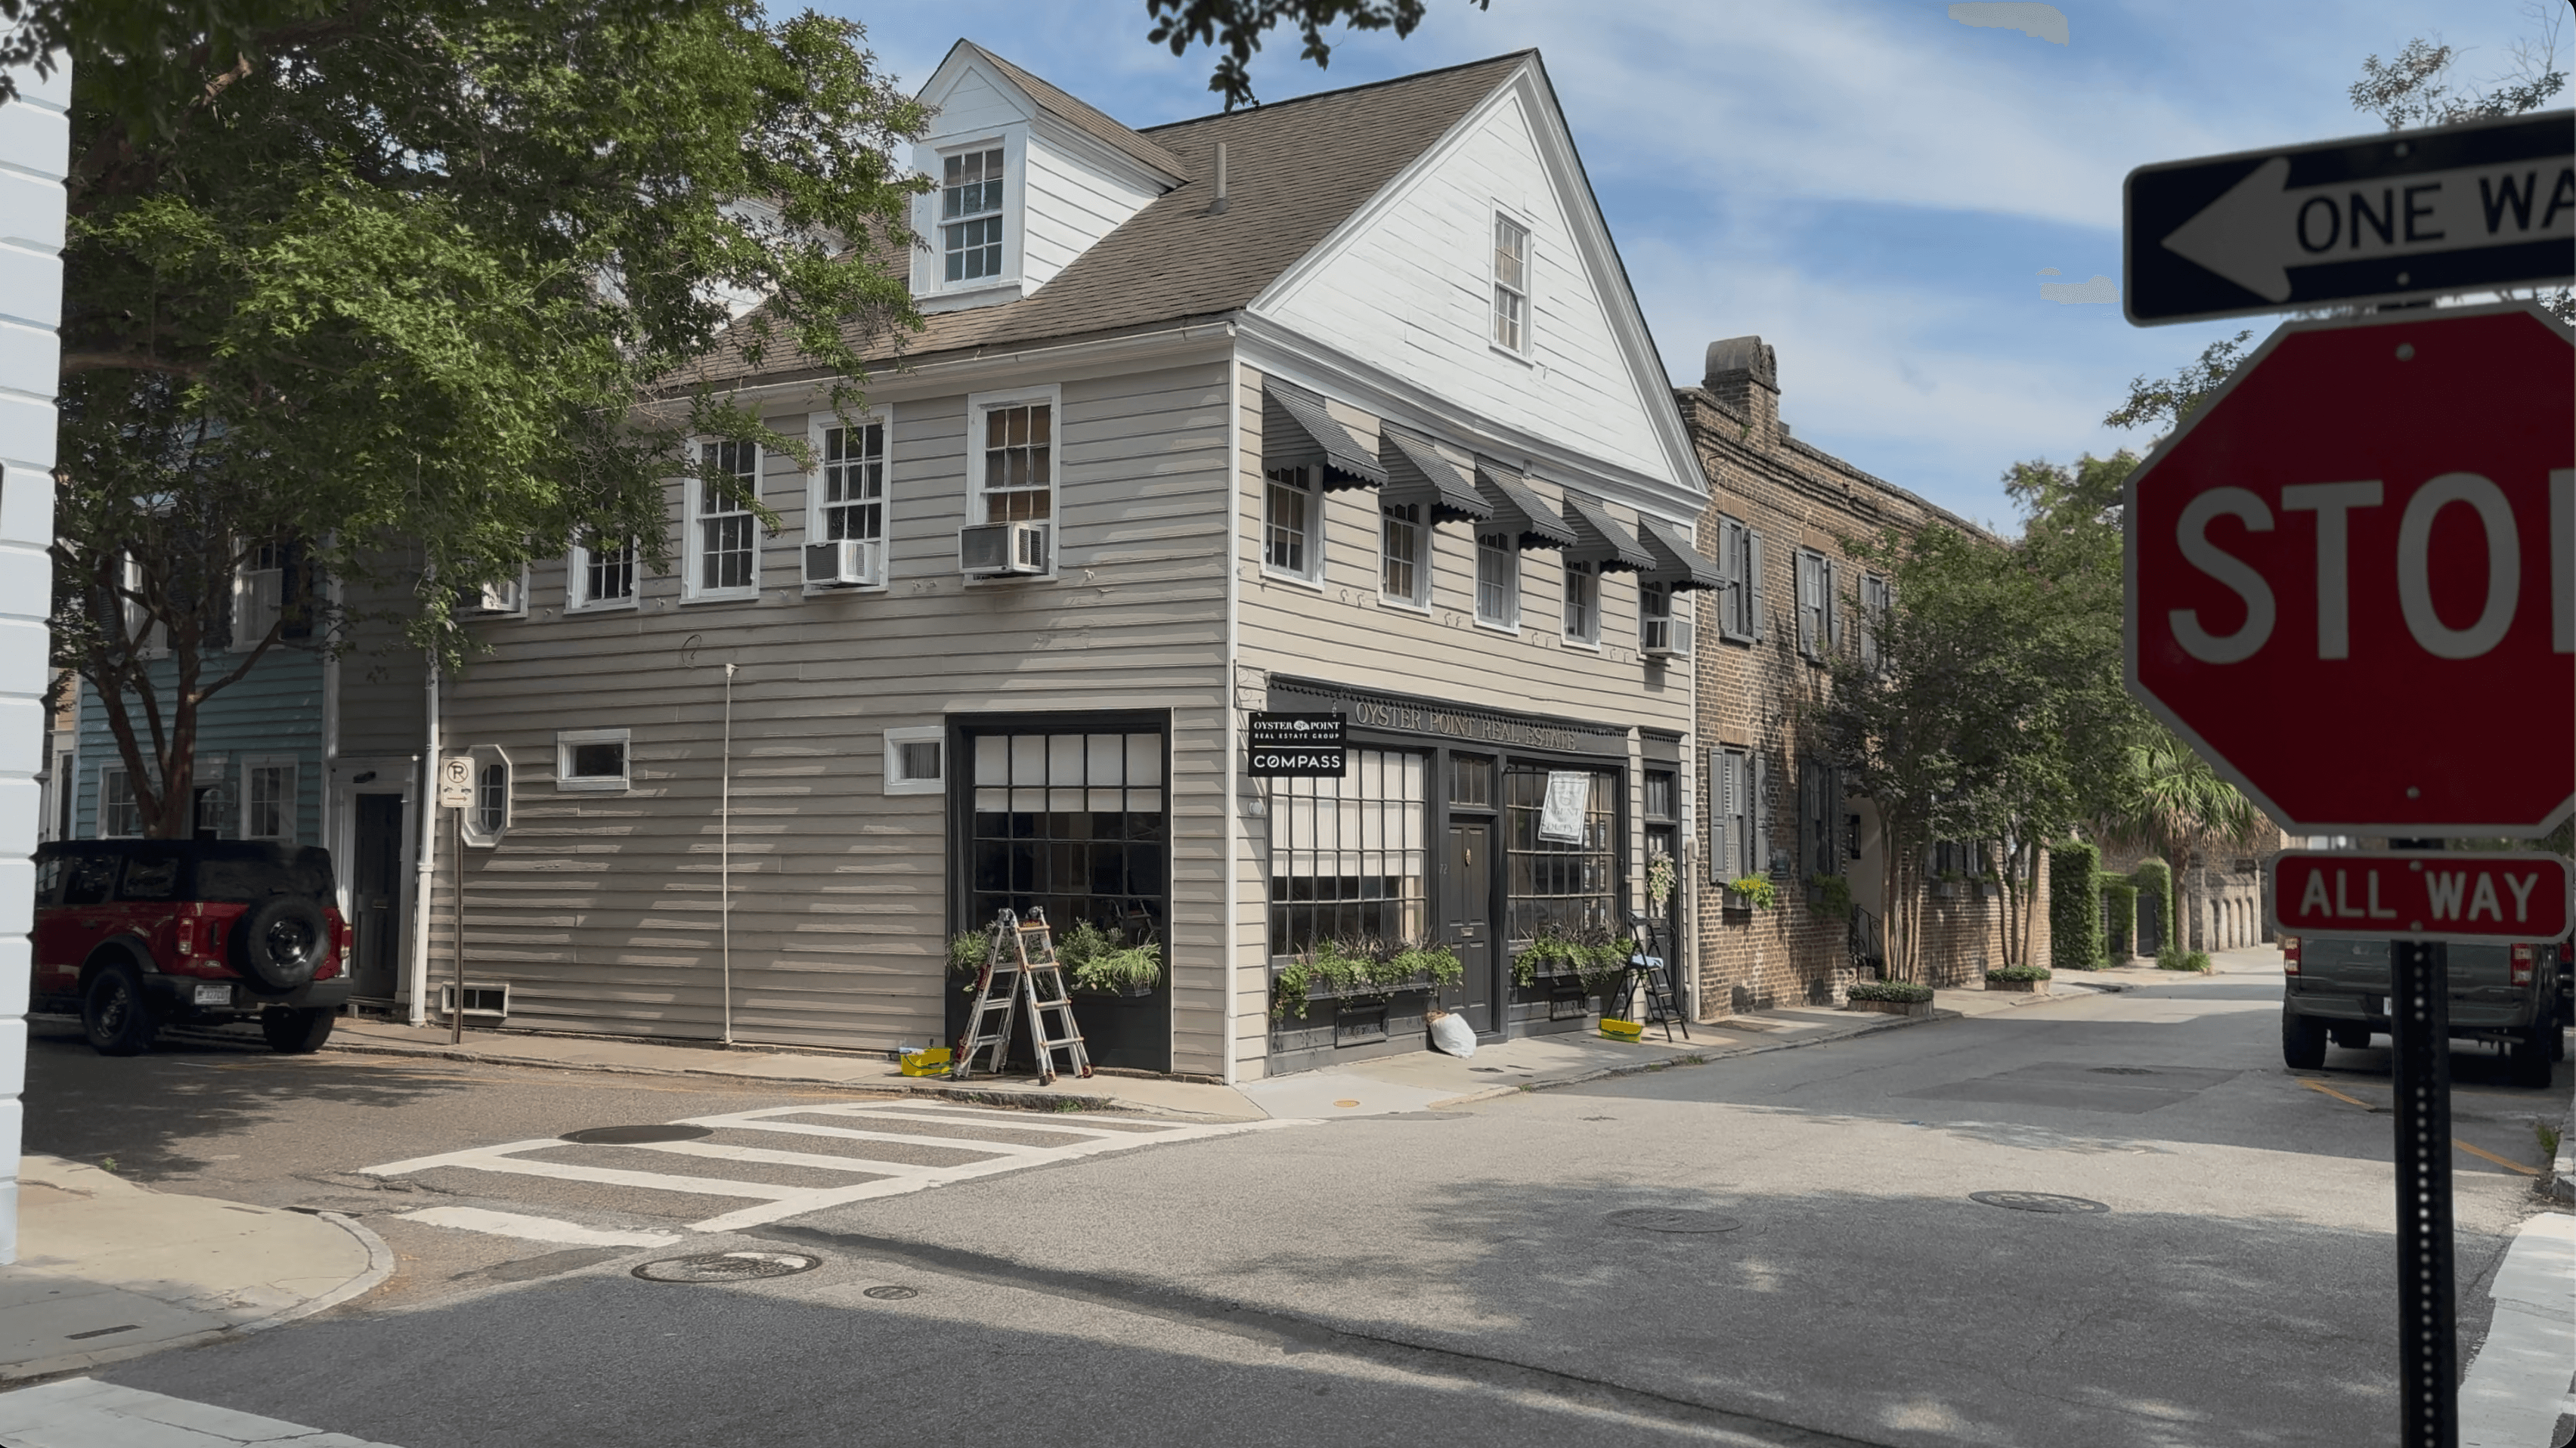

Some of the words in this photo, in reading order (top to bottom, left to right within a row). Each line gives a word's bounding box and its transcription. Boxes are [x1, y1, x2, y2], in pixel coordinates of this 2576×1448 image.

[2296, 182, 2446, 254] ONE
[1254, 721, 1293, 730] OYSTER
[1310, 722, 1340, 730] POINT
[1355, 702, 1421, 730] OYSTER
[1429, 713, 1475, 738] POINT
[1482, 720, 1519, 743] REAL
[1525, 726, 1576, 750] ESTATE
[1253, 755, 1341, 769] COMPASS
[2299, 868, 2398, 920] ALL
[2425, 870, 2539, 923] WAY
